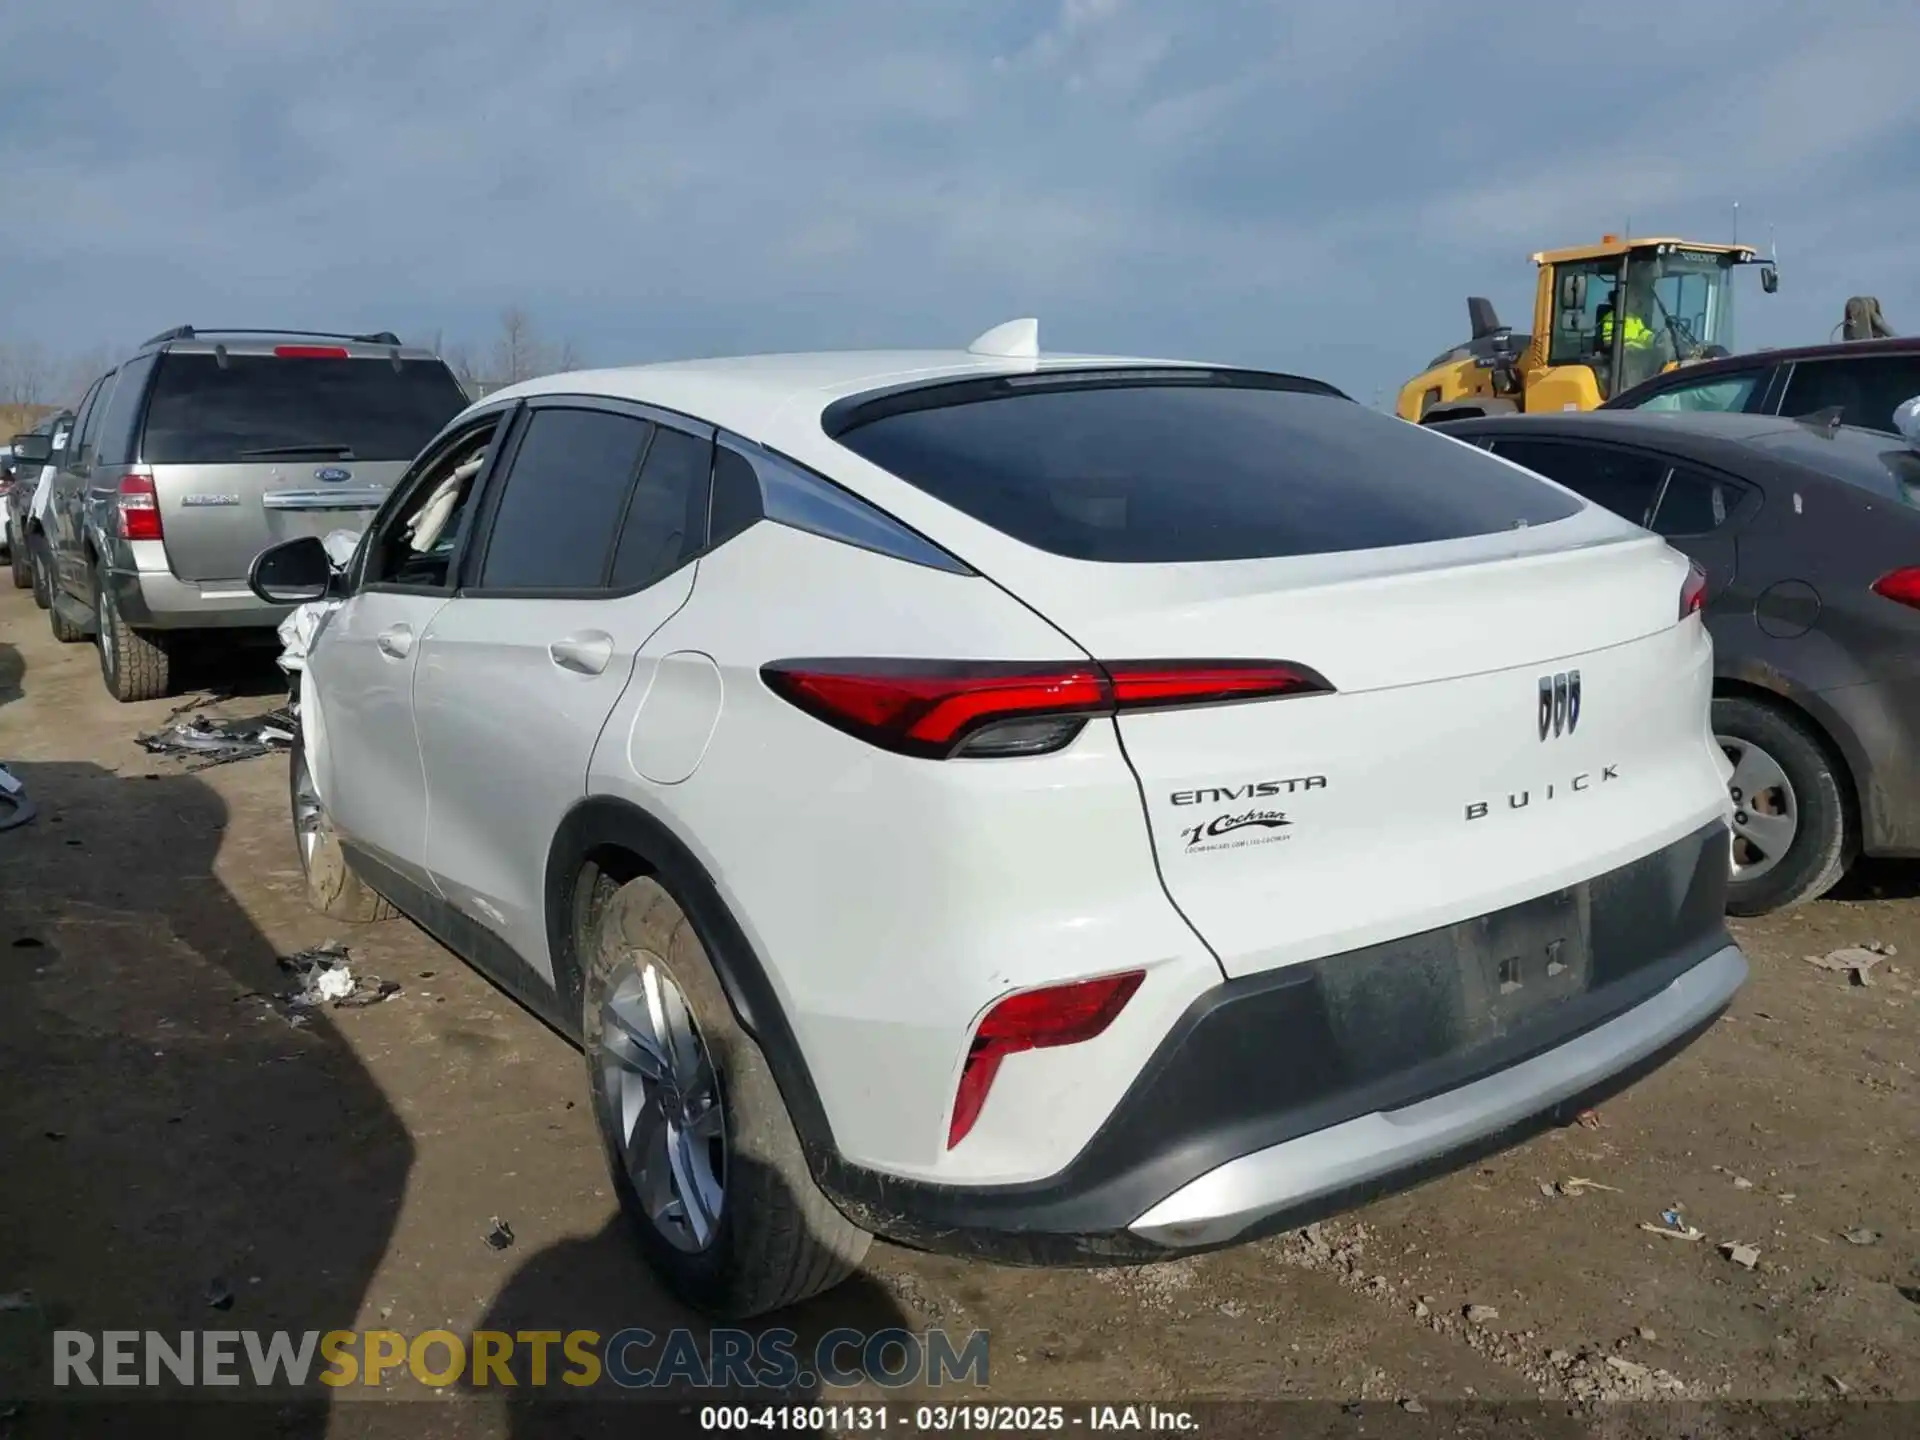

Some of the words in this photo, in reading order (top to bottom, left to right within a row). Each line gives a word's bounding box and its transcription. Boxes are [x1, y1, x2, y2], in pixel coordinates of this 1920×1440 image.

[1170, 775, 1328, 806] ENVISTA
[1465, 763, 1619, 821] BUICK
[1206, 808, 1288, 836] Cochran
